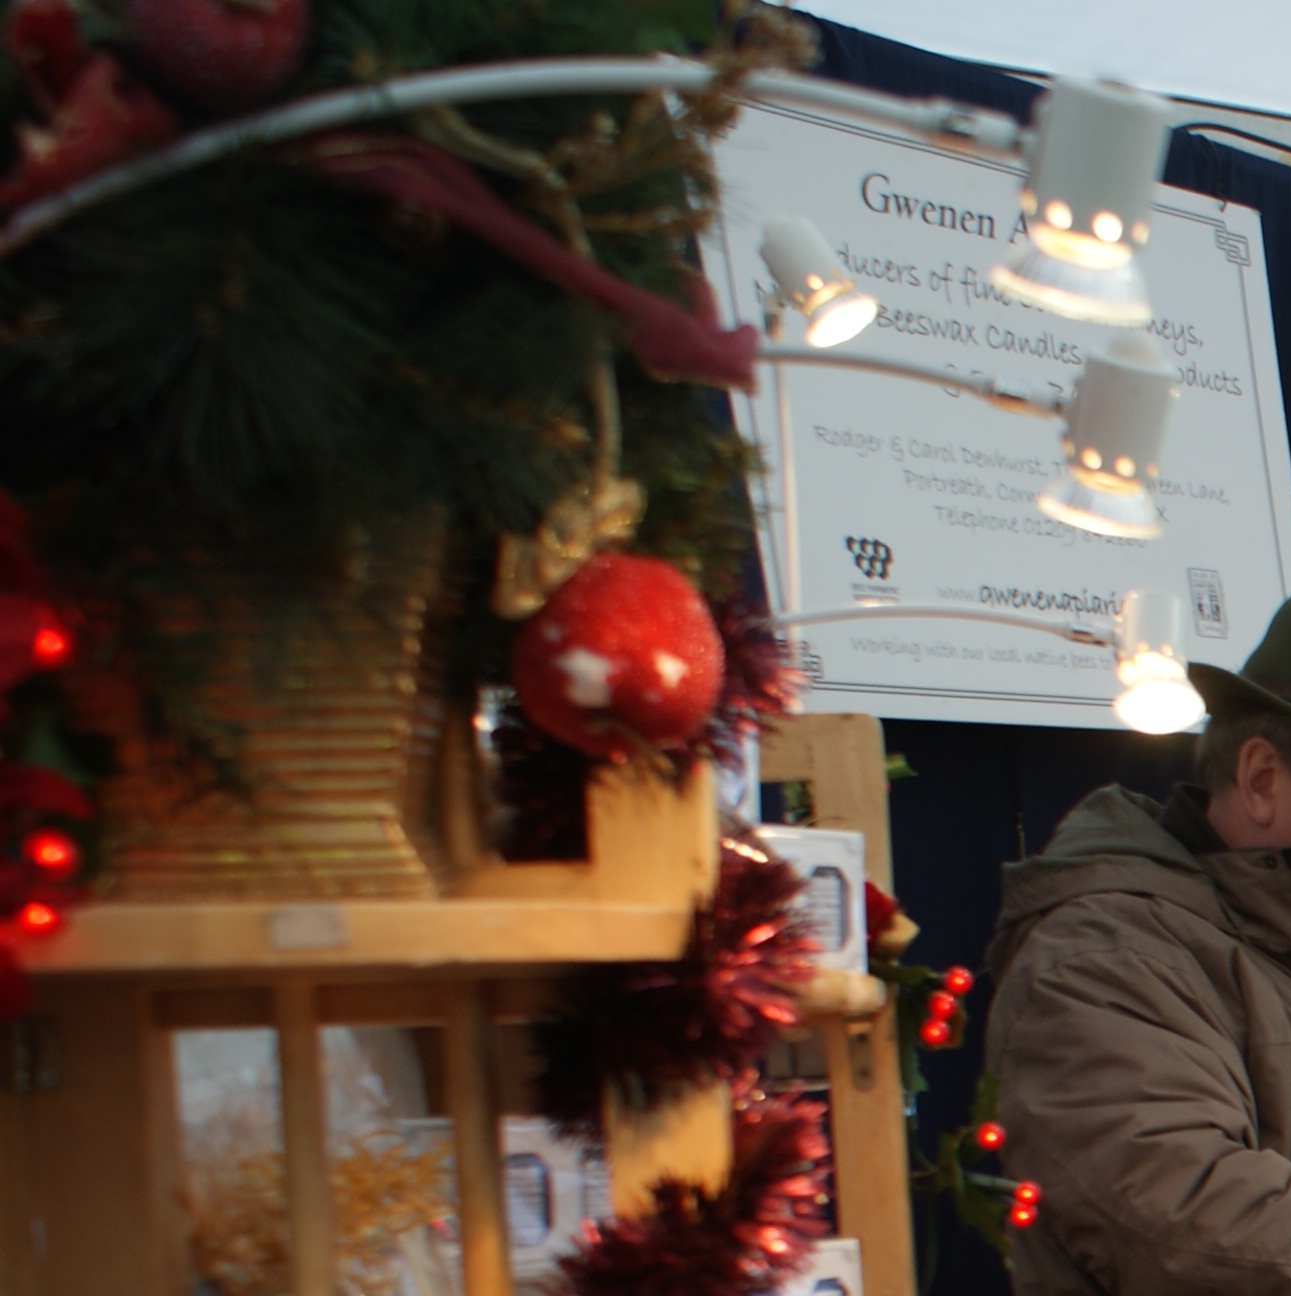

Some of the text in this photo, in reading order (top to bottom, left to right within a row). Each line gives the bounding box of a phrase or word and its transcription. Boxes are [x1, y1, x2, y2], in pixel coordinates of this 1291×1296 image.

[861, 173, 997, 240] Gwenen
[929, 265, 955, 304] of
[985, 323, 1083, 366] Candles
[907, 438, 957, 464] Carol
[933, 505, 1020, 536] Telephone
